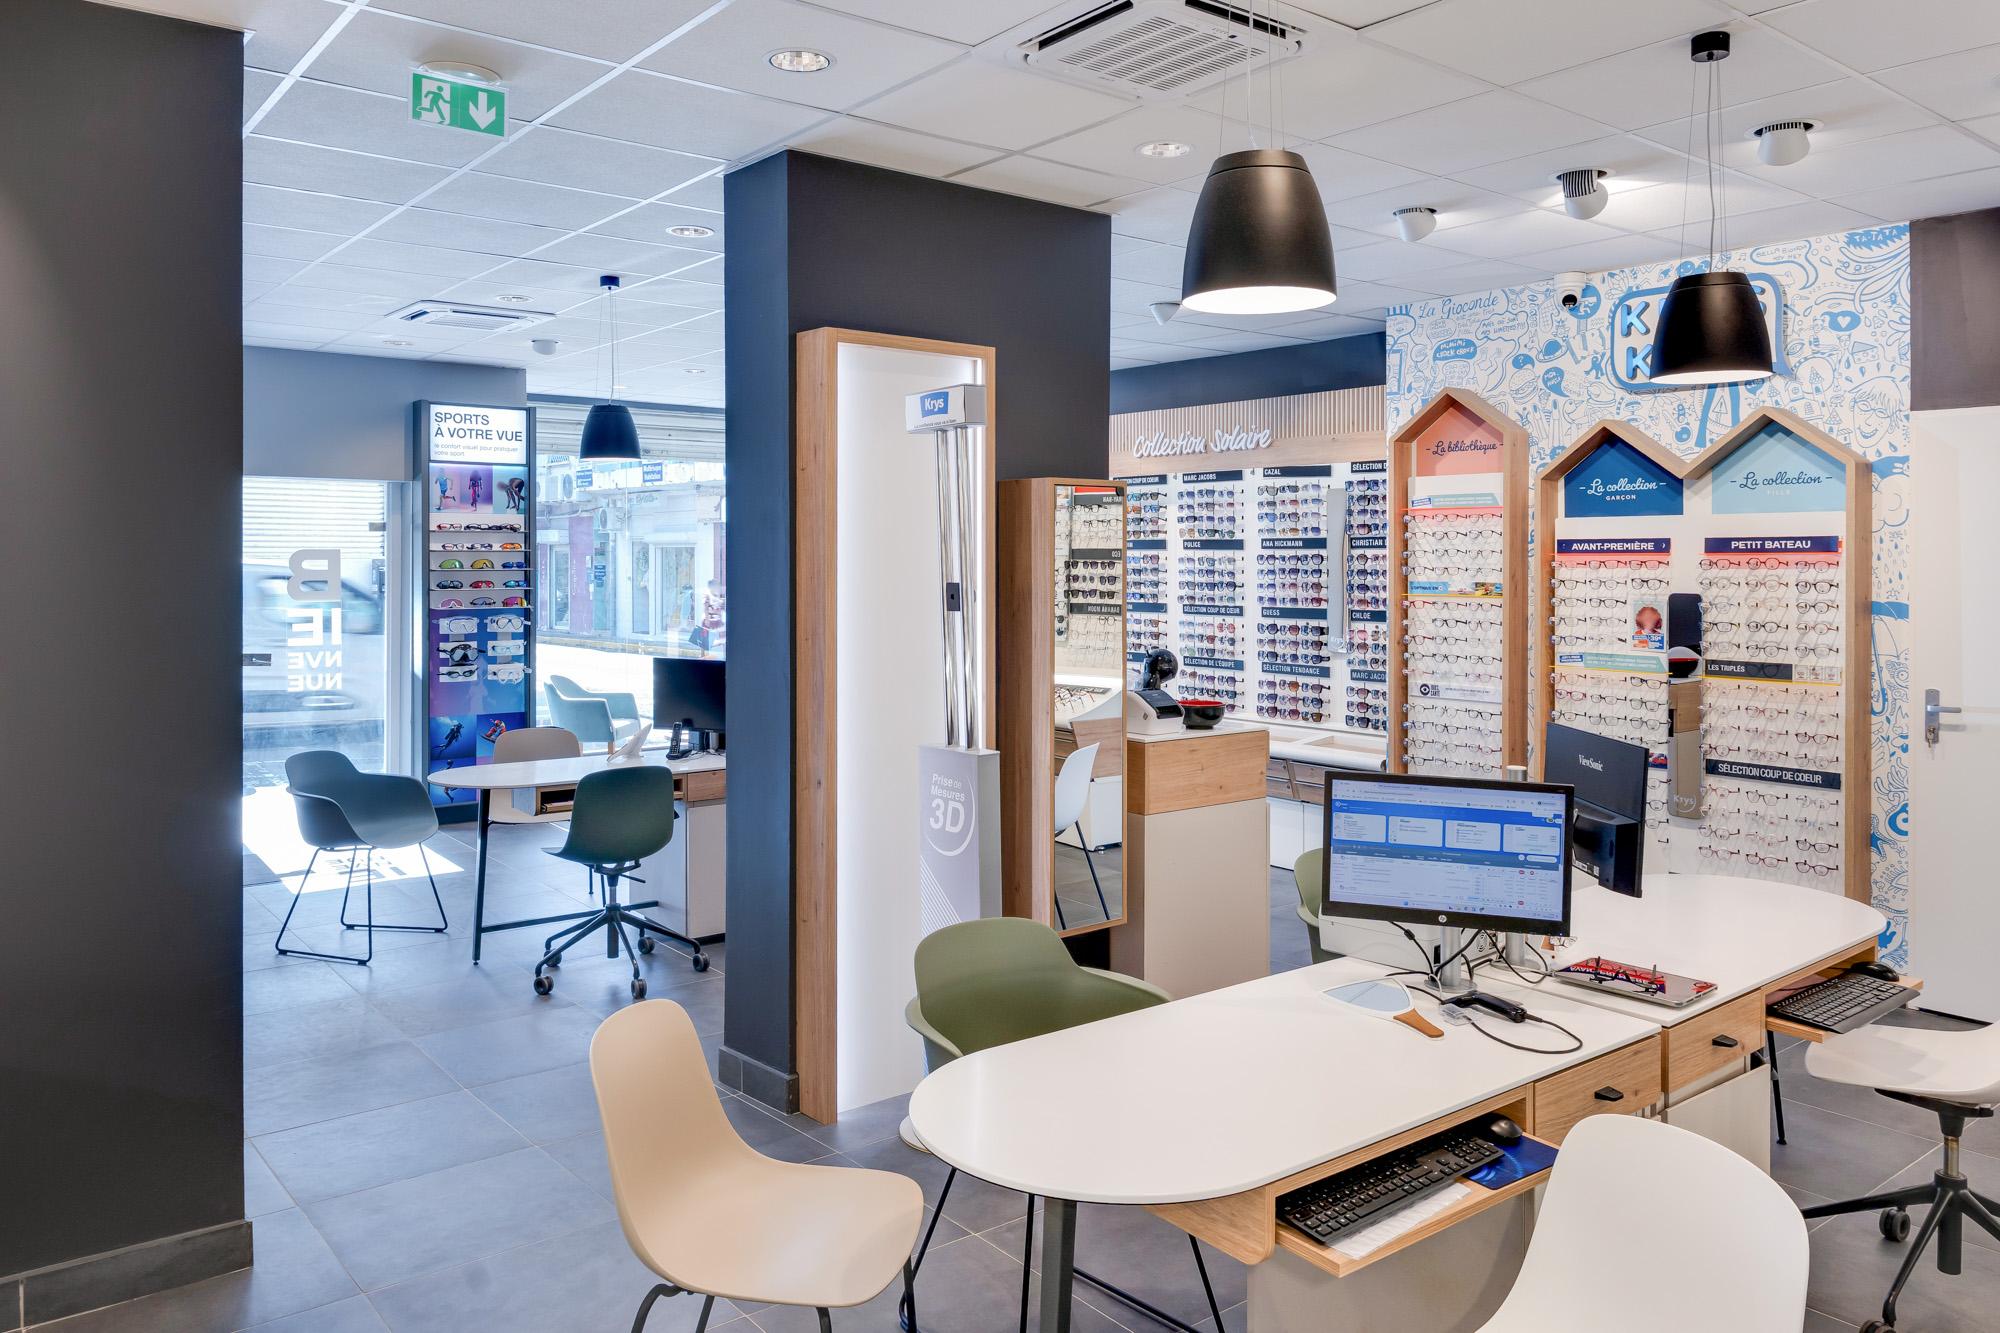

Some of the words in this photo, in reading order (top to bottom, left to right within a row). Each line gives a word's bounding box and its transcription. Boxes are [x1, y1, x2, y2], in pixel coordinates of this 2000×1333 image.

[1440, 290, 1498, 320] Gioconde
[924, 398, 944, 412] Krys
[434, 412, 490, 426] SPORTS
[434, 424, 444, 438] À
[448, 428, 493, 440] VOTRE
[496, 430, 522, 442] VUE
[1133, 430, 1206, 458] Collection
[1210, 425, 1273, 452] Solaire
[1432, 440, 1446, 456] La
[1447, 440, 1498, 454] bibliothèque
[1587, 479, 1605, 496] La
[1606, 478, 1658, 492] collection
[1740, 472, 1759, 490] La
[1762, 471, 1822, 486] collection
[1572, 541, 1654, 550] AVANT-PREMIÈRE
[1731, 540, 1762, 549] PETIT
[1764, 540, 1811, 548] BATEAU
[1720, 664, 1745, 672] TRIPLÉS
[1578, 754, 1603, 772] ViewSonic
[932, 774, 953, 788] Prise
[953, 780, 962, 789] de
[1718, 763, 1760, 776] SÉLECTION
[1760, 768, 1782, 780] COUP
[1782, 771, 1793, 780] DE
[1794, 772, 1822, 783] COEUR
[930, 784, 965, 802] Mesures
[1673, 794, 1694, 806] Krys
[929, 798, 965, 834] 3D
